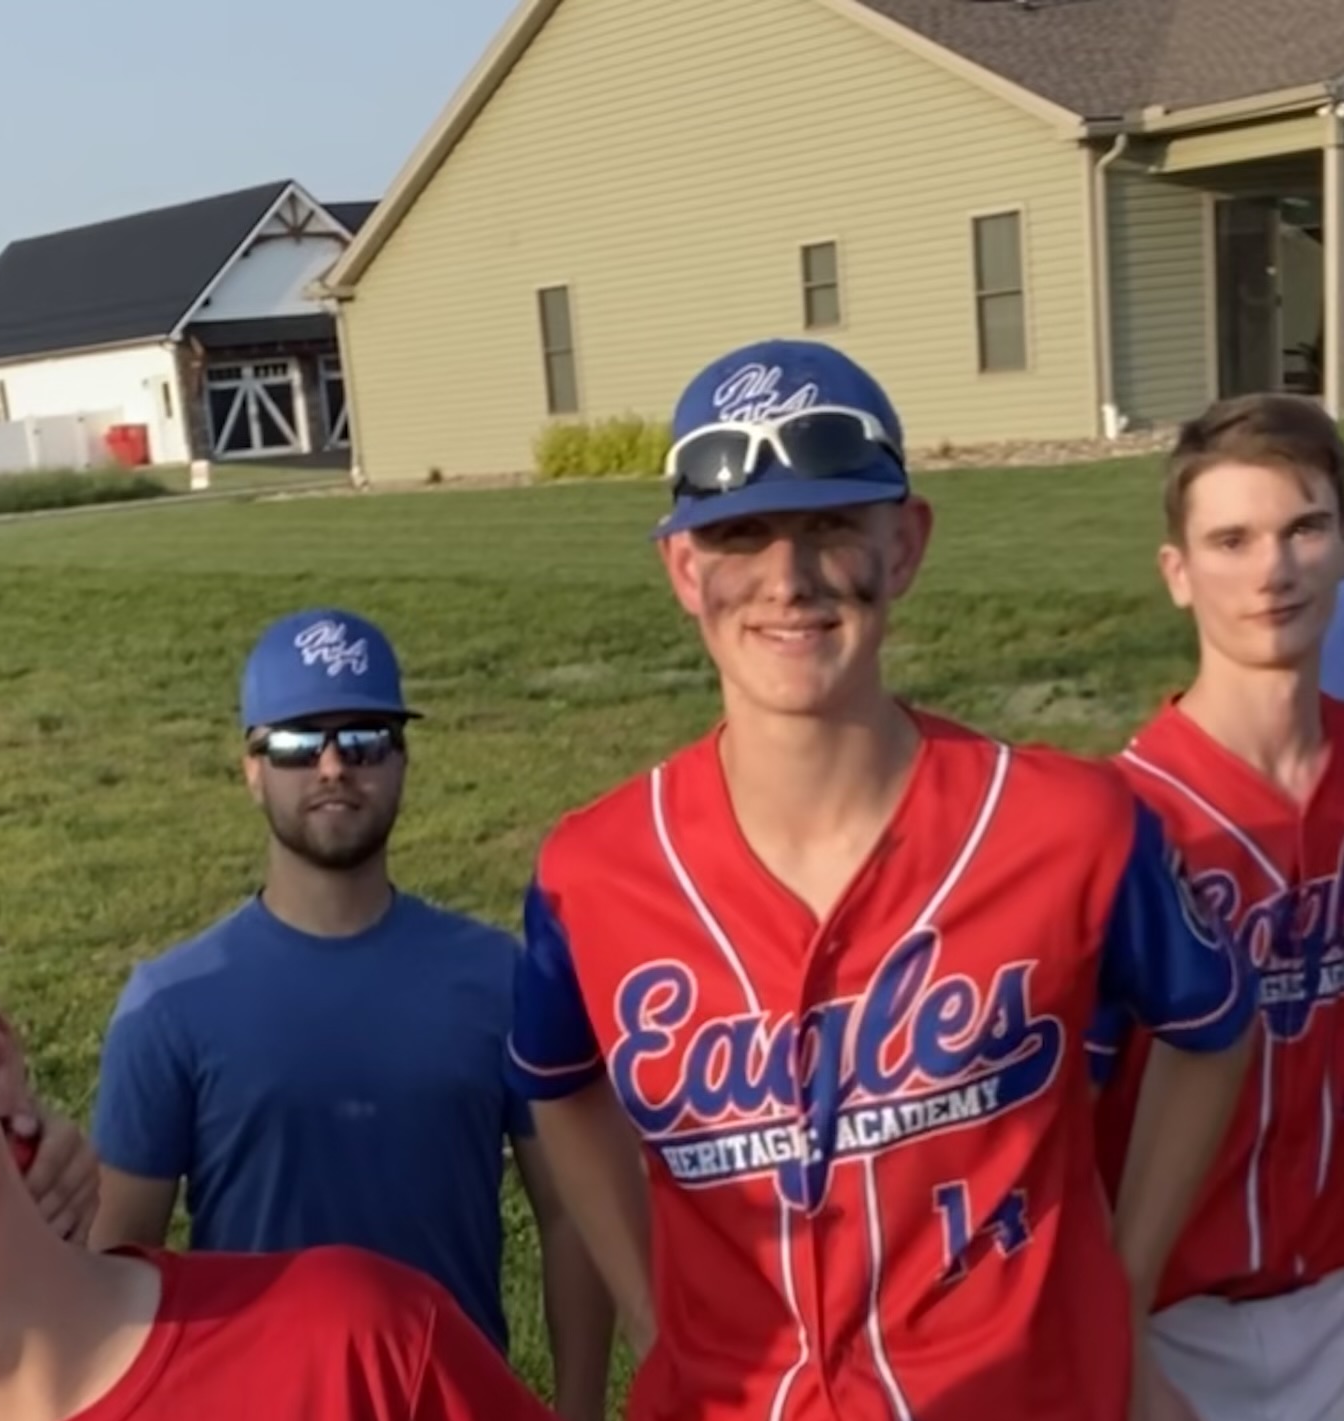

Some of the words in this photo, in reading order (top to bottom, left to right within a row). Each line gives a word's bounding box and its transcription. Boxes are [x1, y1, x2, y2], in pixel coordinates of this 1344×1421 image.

[608, 926, 1066, 1213] Eagles
[661, 1126, 822, 1179] HERITAGE
[836, 1077, 1001, 1151] ACADEMY
